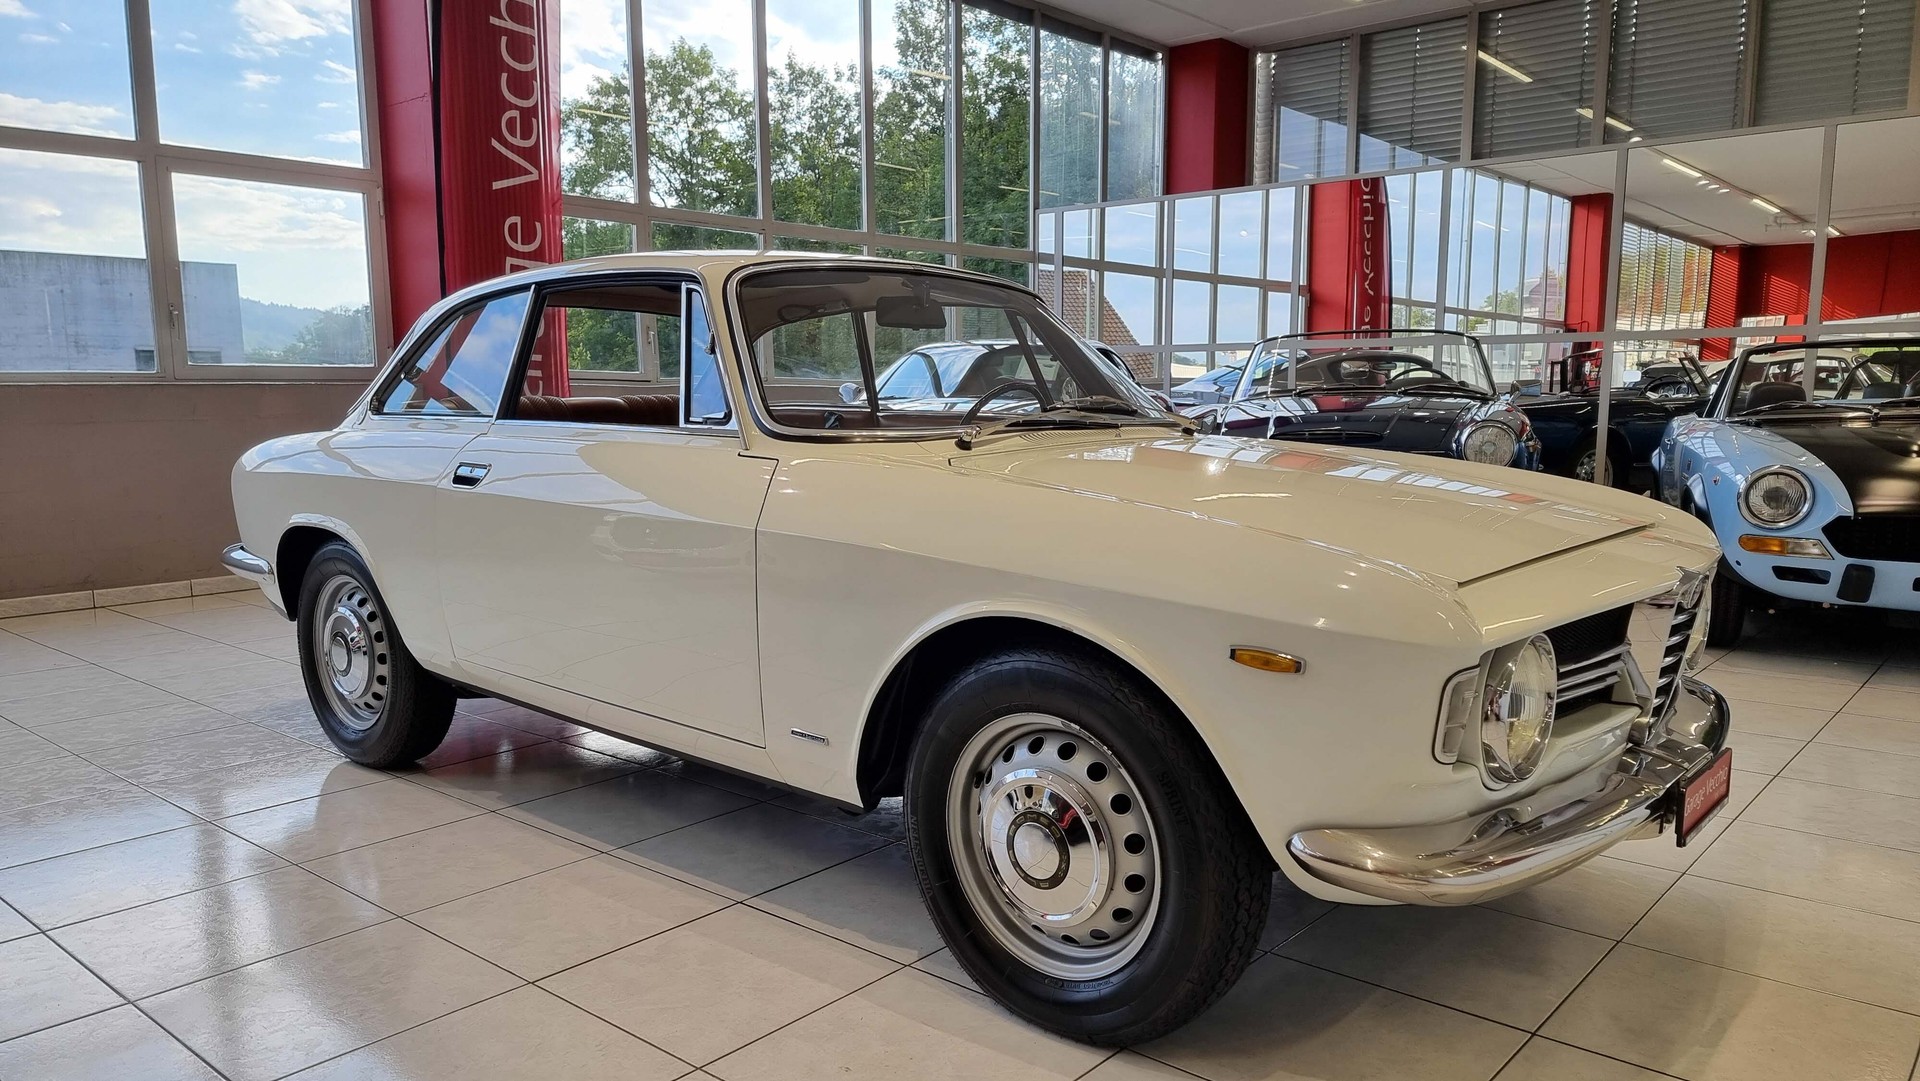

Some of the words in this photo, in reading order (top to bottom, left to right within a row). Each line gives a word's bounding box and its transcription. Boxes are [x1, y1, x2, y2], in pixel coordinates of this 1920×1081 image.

[1158, 771, 1189, 827] SPRINT
[1685, 787, 1705, 816] Garage
[1706, 765, 1728, 795] Vecchio
[909, 815, 934, 897] VREDESTEIN
